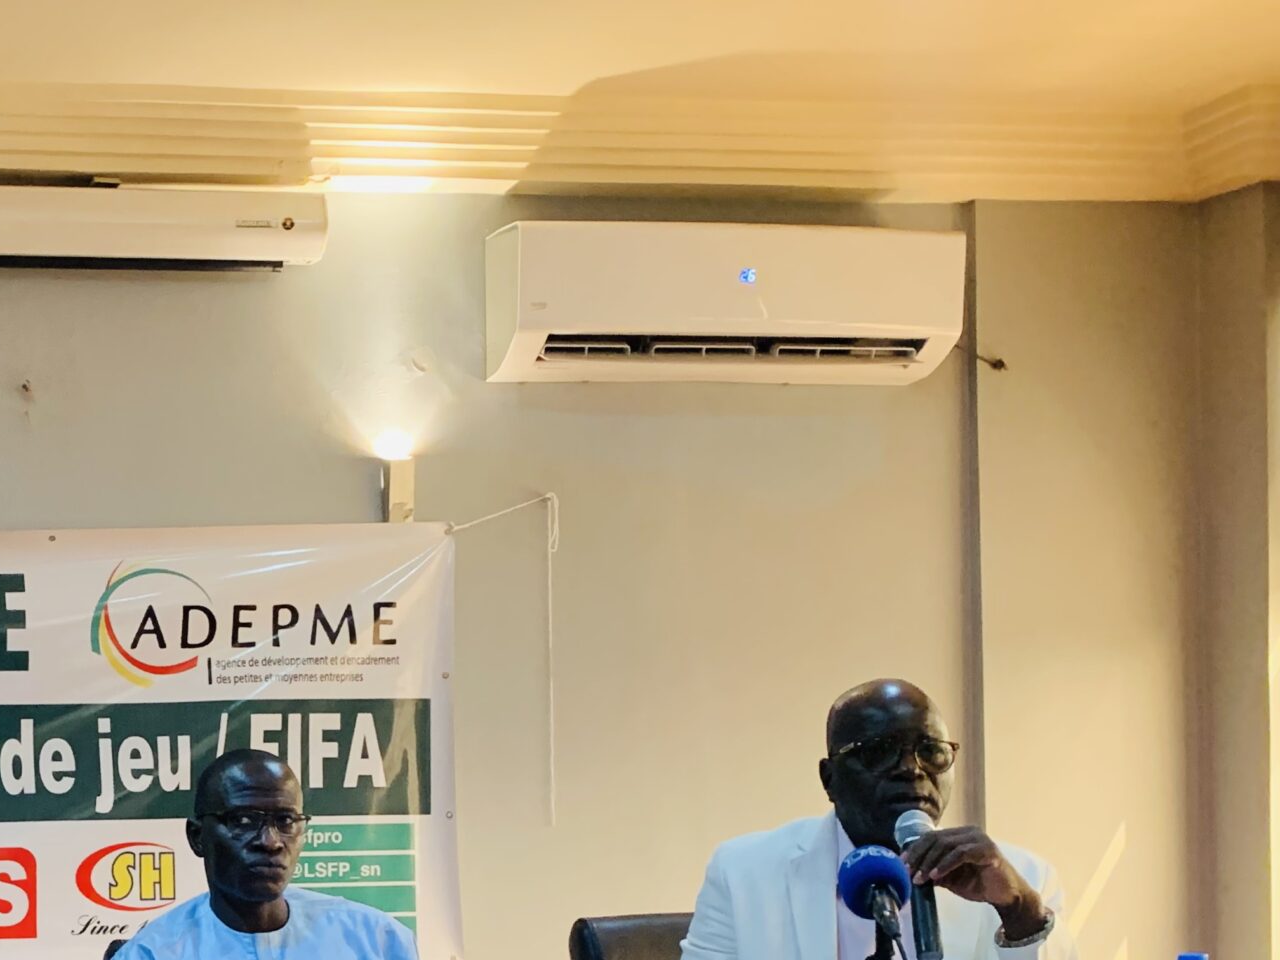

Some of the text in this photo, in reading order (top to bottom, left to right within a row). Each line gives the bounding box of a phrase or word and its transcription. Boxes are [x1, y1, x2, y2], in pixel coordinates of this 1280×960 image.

[130, 602, 397, 649] ADEPME
[215, 658, 247, 670] agence
[248, 656, 260, 667] de
[329, 656, 338, 666] et
[216, 674, 232, 684] des
[233, 673, 263, 685] petites
[264, 674, 273, 683] et
[320, 671, 364, 683] entreprises
[0, 719, 76, 796] de
[94, 717, 191, 814] jeu
[250, 712, 387, 788] FIFA
[109, 851, 176, 901] SH
[71, 914, 129, 935] Since
